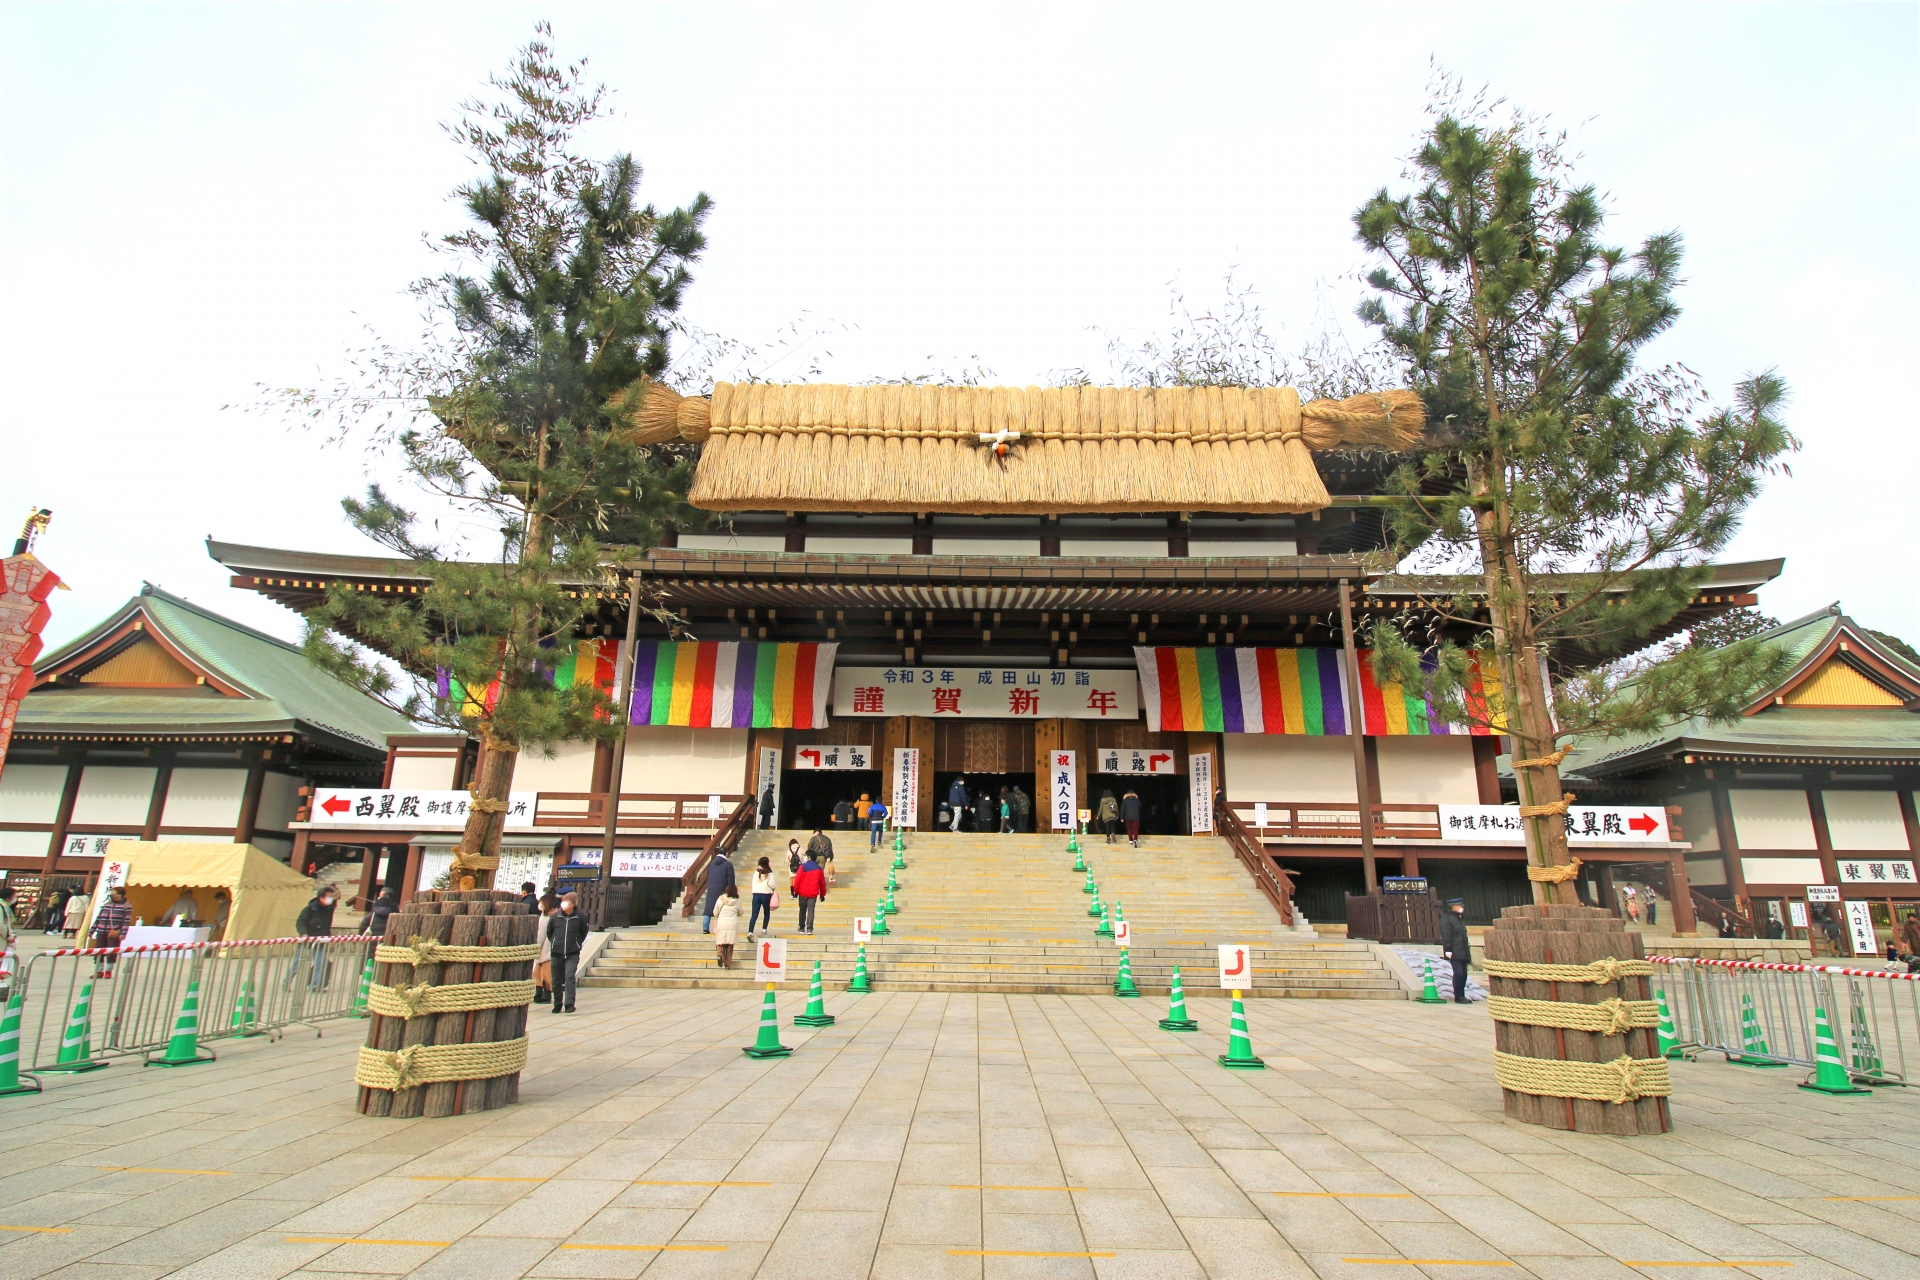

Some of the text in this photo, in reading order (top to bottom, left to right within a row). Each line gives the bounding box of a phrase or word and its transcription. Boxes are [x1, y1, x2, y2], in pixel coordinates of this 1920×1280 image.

[883, 669, 1090, 686] 令和3年 成田山初詣
[853, 687, 1119, 716] 謹賀新年
[825, 754, 866, 767] 順路
[1105, 757, 1146, 771] 順路
[1057, 754, 1071, 825] 祝 成人の日
[355, 794, 528, 819] 西翼殿 御護摩所
[1564, 811, 1626, 837] 東翼殿
[69, 837, 133, 855] 西翼
[643, 863, 689, 871] い・ろ・は・に・
[1844, 863, 1911, 880] 東翼殿
